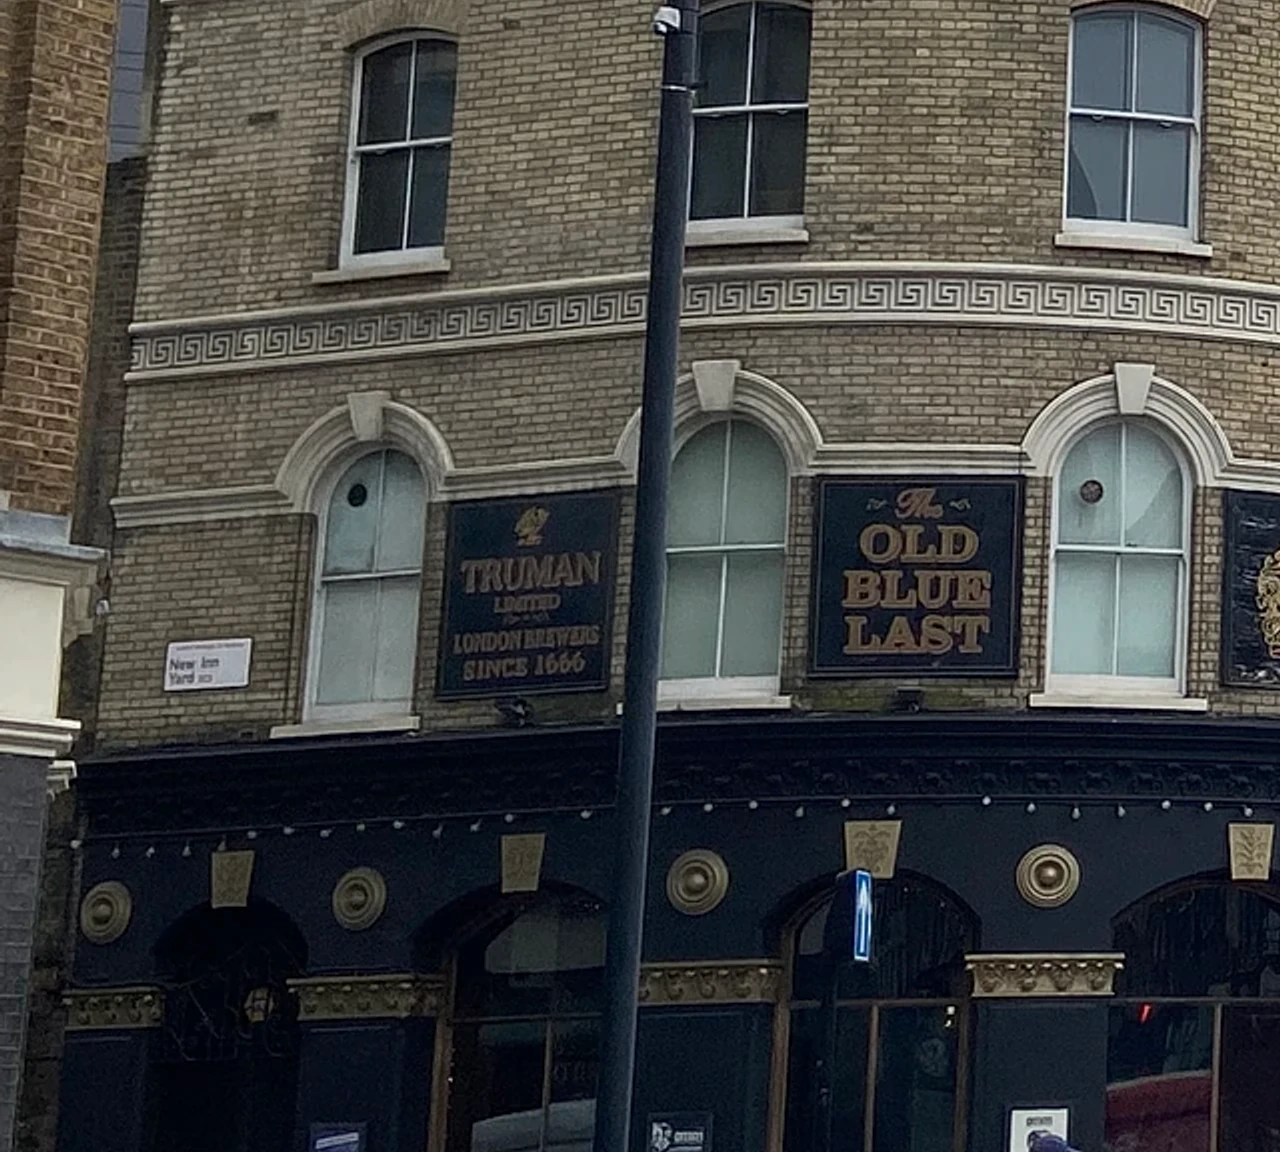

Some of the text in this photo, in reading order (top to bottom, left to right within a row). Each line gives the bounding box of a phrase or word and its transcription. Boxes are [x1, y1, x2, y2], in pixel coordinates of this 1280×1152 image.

[894, 487, 944, 519] The
[859, 523, 980, 564] OLD
[461, 551, 601, 594] TRUMAN
[842, 569, 992, 610] BLUE
[453, 624, 601, 655] LONDON BREWERS
[843, 614, 990, 656] LAST
[169, 671, 195, 686] Yard
[170, 656, 219, 671] New Inn
[463, 651, 586, 682] SINCE 1666
